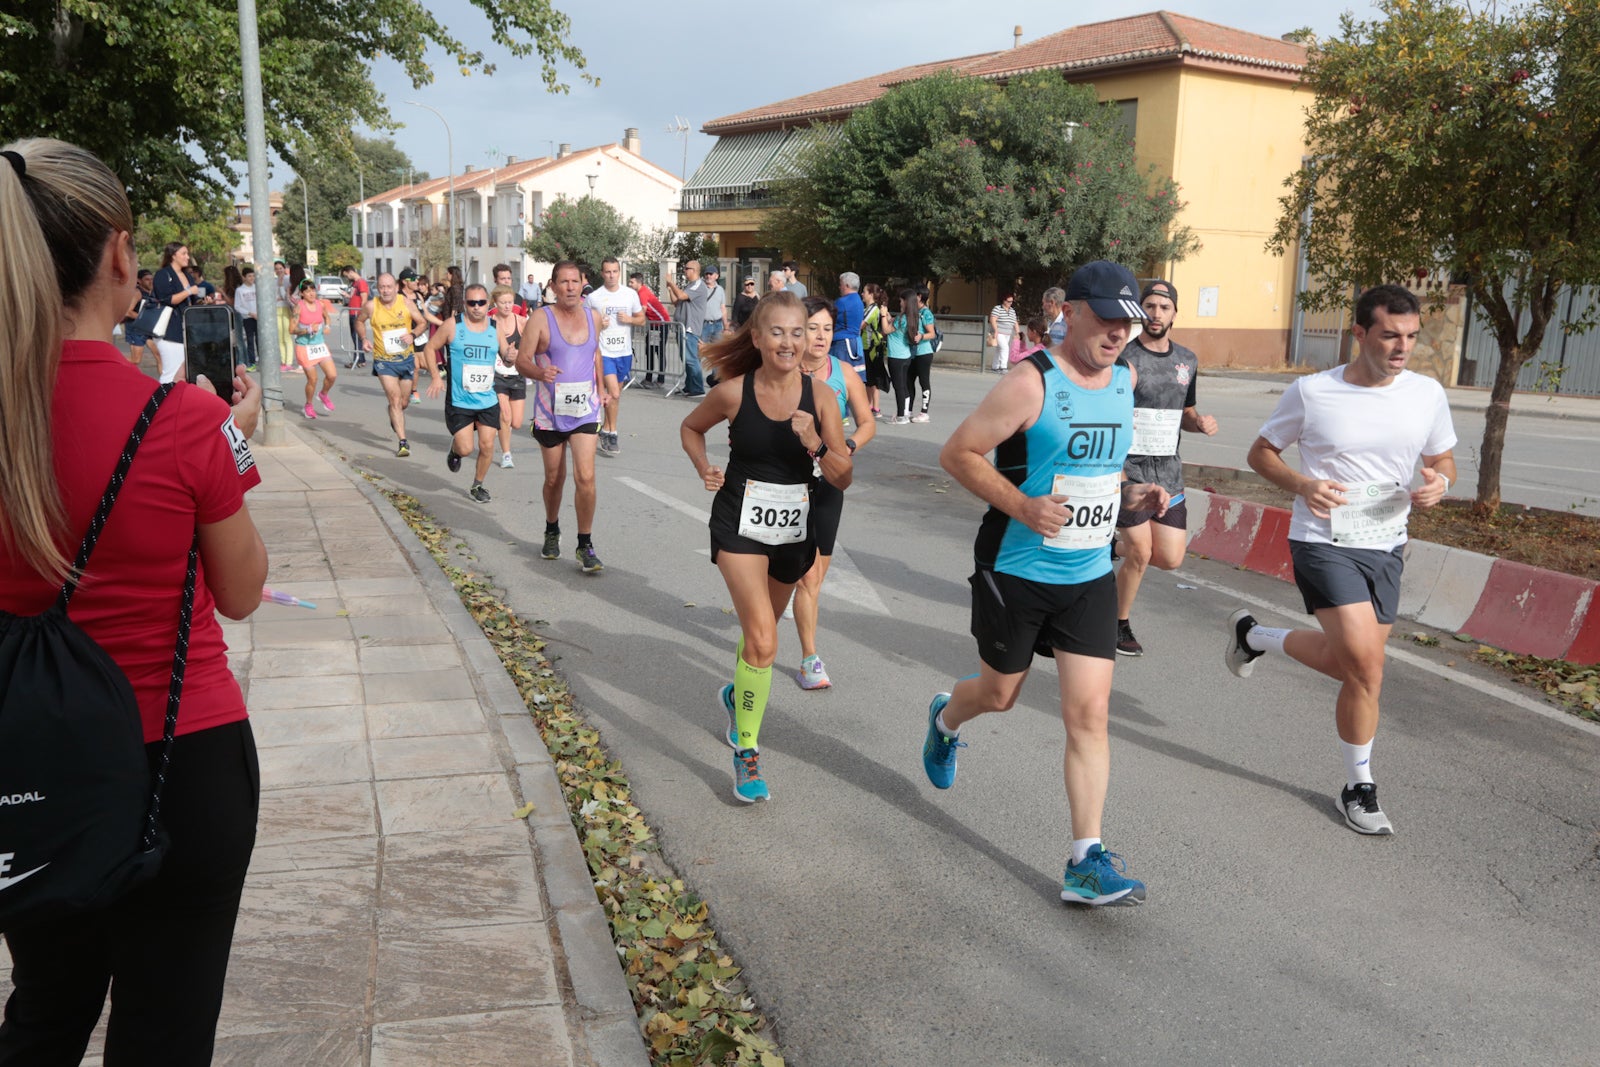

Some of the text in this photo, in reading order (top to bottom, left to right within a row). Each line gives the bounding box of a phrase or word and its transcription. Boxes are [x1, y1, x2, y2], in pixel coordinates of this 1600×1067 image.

[606, 337, 625, 345] 3052
[463, 344, 492, 360] GIIT
[469, 373, 488, 383] 537
[922, 389, 930, 410] FILA
[234, 439, 249, 459] MO
[1067, 422, 1122, 460] GIIT
[749, 505, 802, 528] 3032
[0, 791, 46, 806] ADAL
